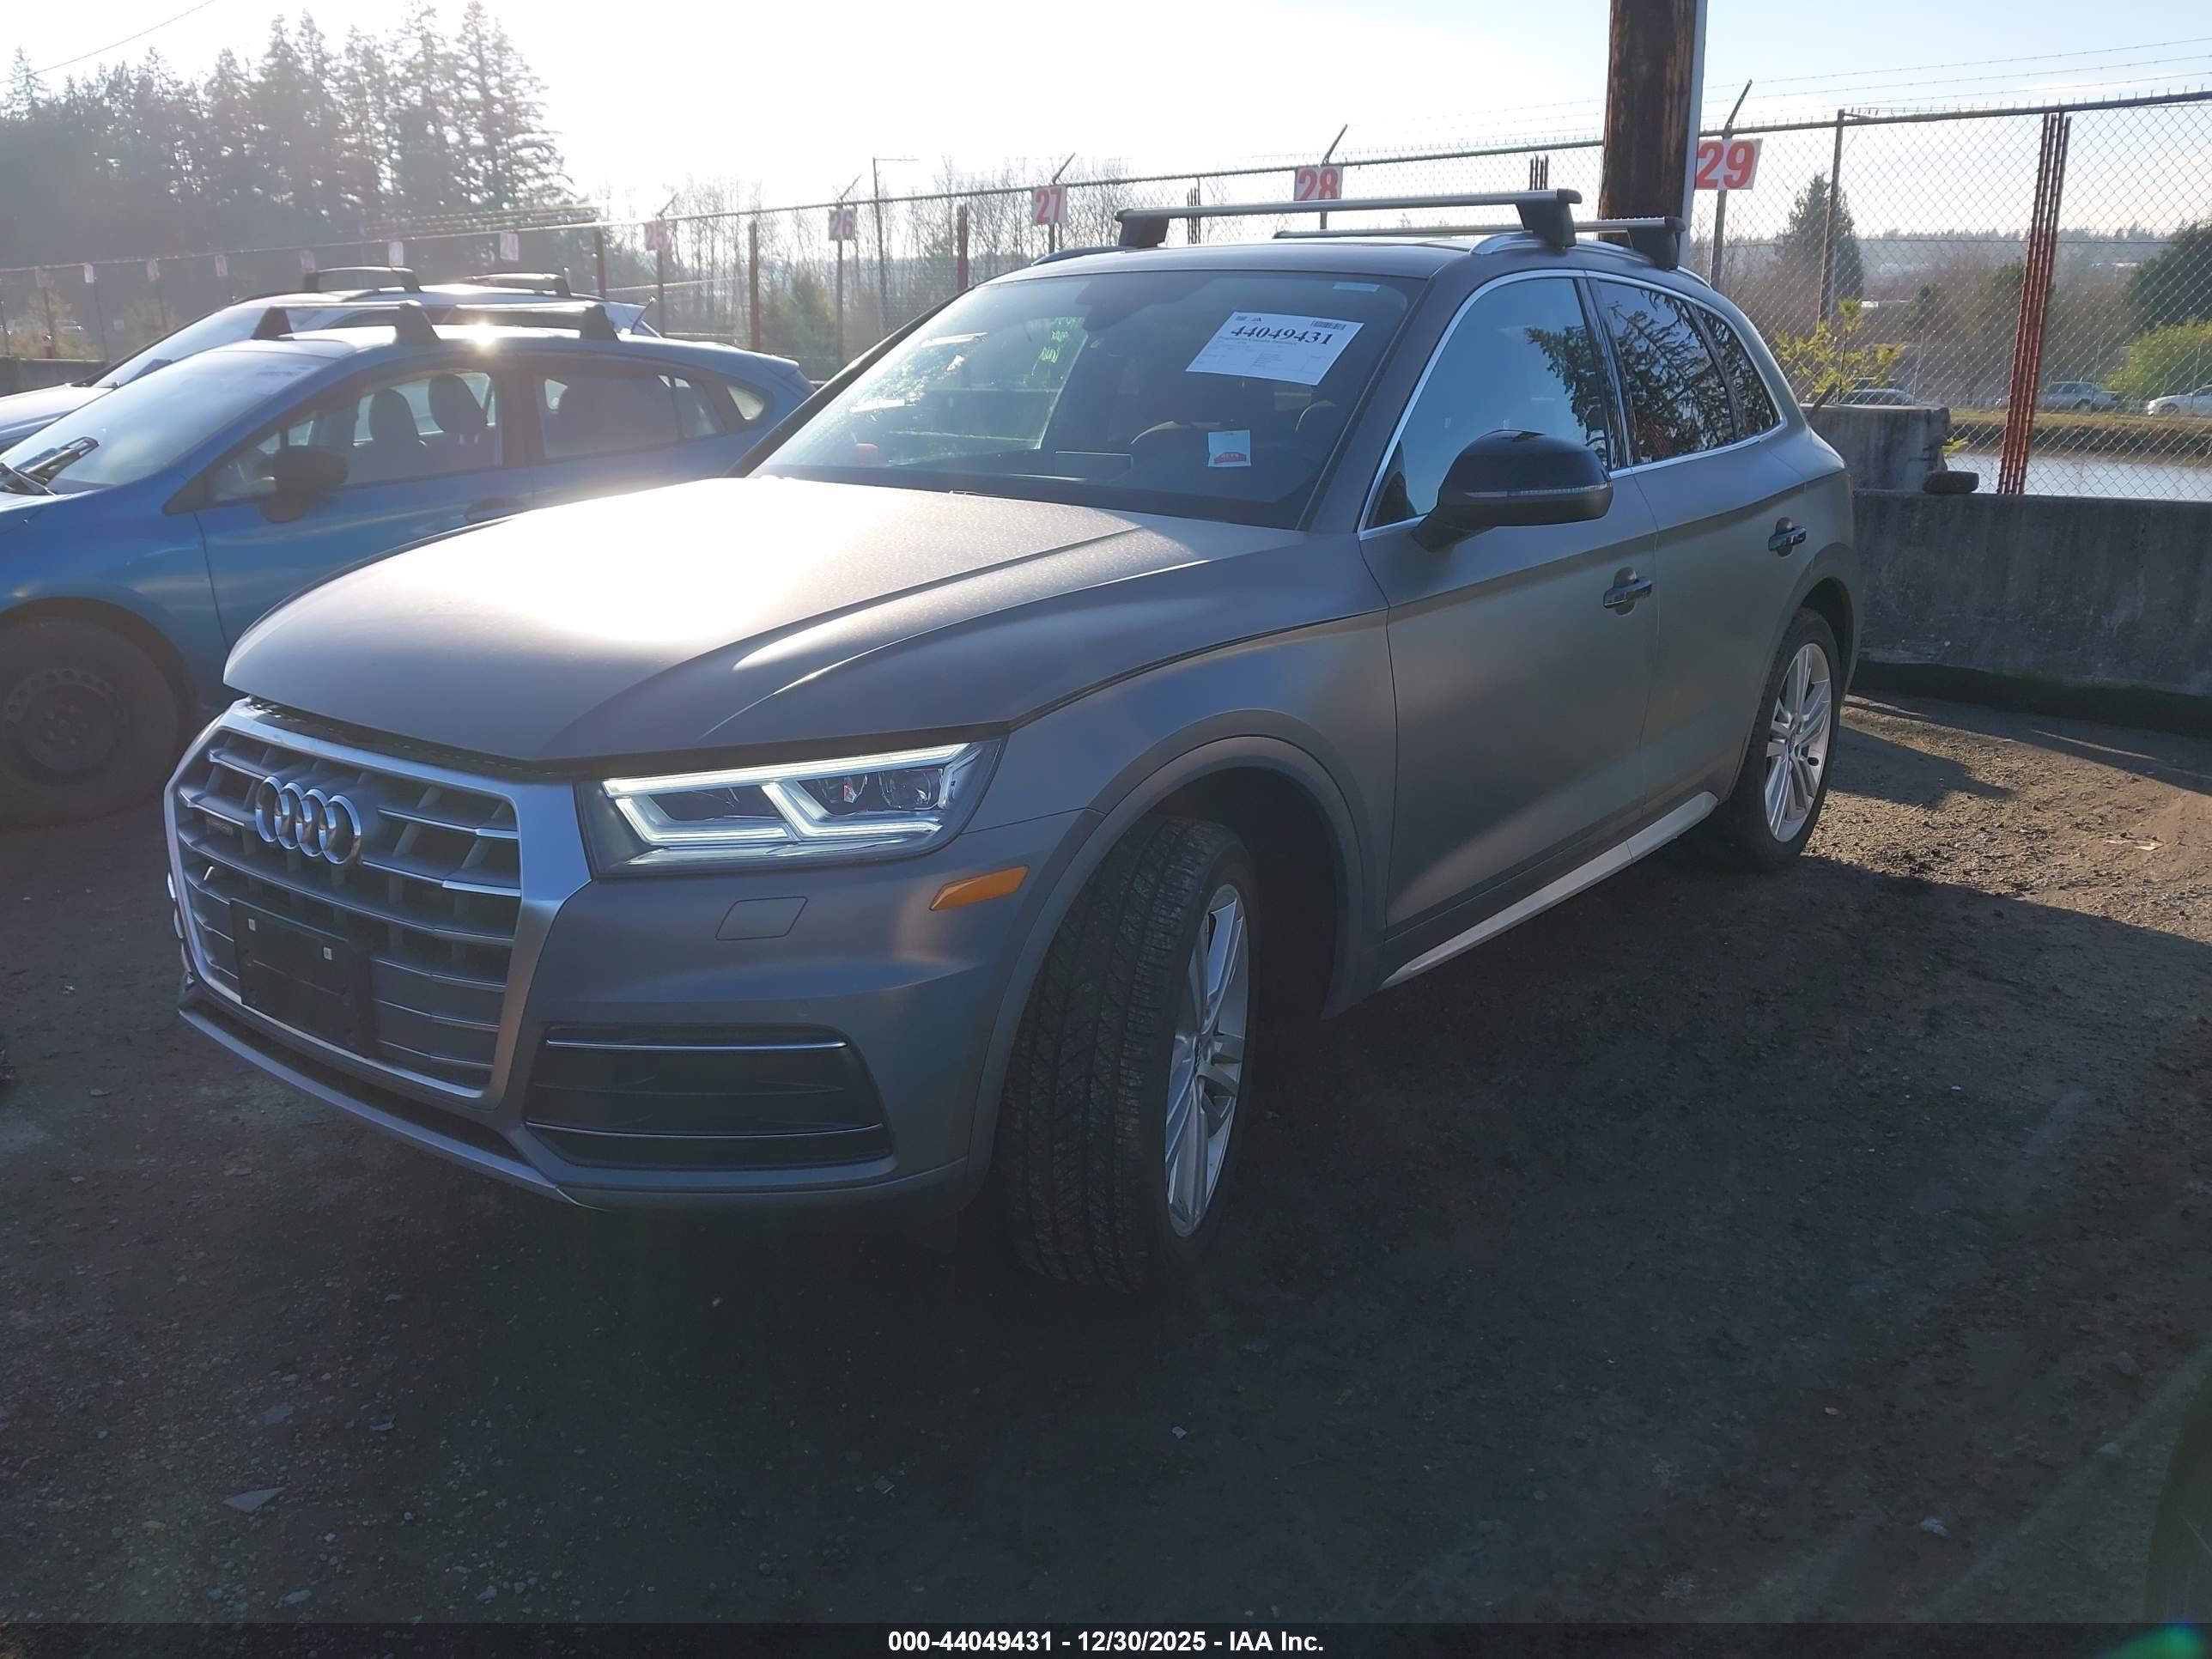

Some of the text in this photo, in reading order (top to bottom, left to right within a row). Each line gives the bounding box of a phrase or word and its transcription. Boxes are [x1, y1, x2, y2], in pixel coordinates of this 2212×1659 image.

[1696, 141, 1755, 188] 29
[1297, 167, 1339, 200] 28
[1036, 188, 1062, 223] 27
[830, 211, 854, 240] 26
[1231, 325, 1334, 345] 44049431
